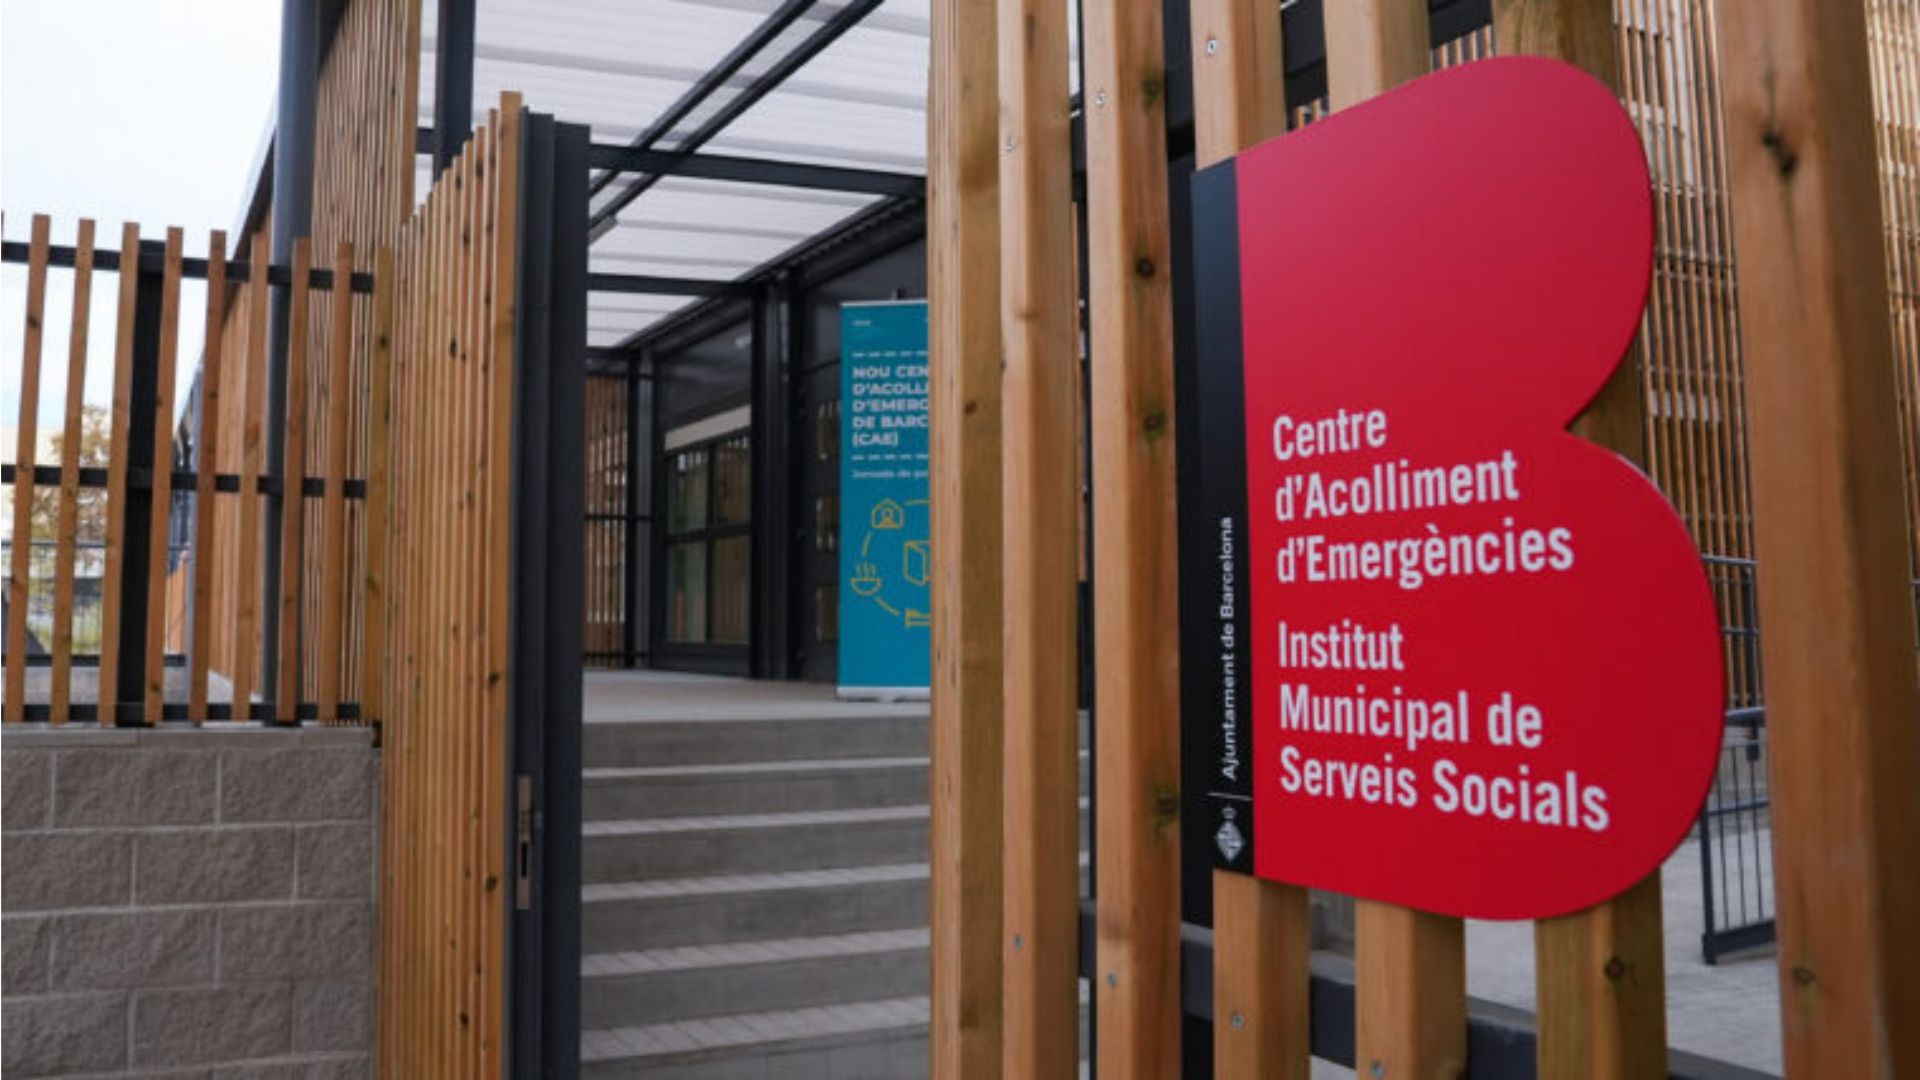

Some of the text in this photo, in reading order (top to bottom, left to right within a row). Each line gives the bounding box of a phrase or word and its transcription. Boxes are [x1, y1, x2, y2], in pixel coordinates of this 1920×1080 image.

[853, 366, 890, 379] NOU
[853, 414, 929, 429] DE BARC
[853, 431, 898, 447] (CAE)
[1273, 408, 1387, 461] Centre
[1275, 450, 1520, 522] d'Acolliment
[1277, 517, 1574, 590] d'Emergències
[1219, 517, 1239, 780] Ajuntament de Barcelona
[1278, 619, 1404, 670] Institut
[1280, 683, 1542, 751] Municipal de
[1280, 745, 1609, 831] Serveis Socials
